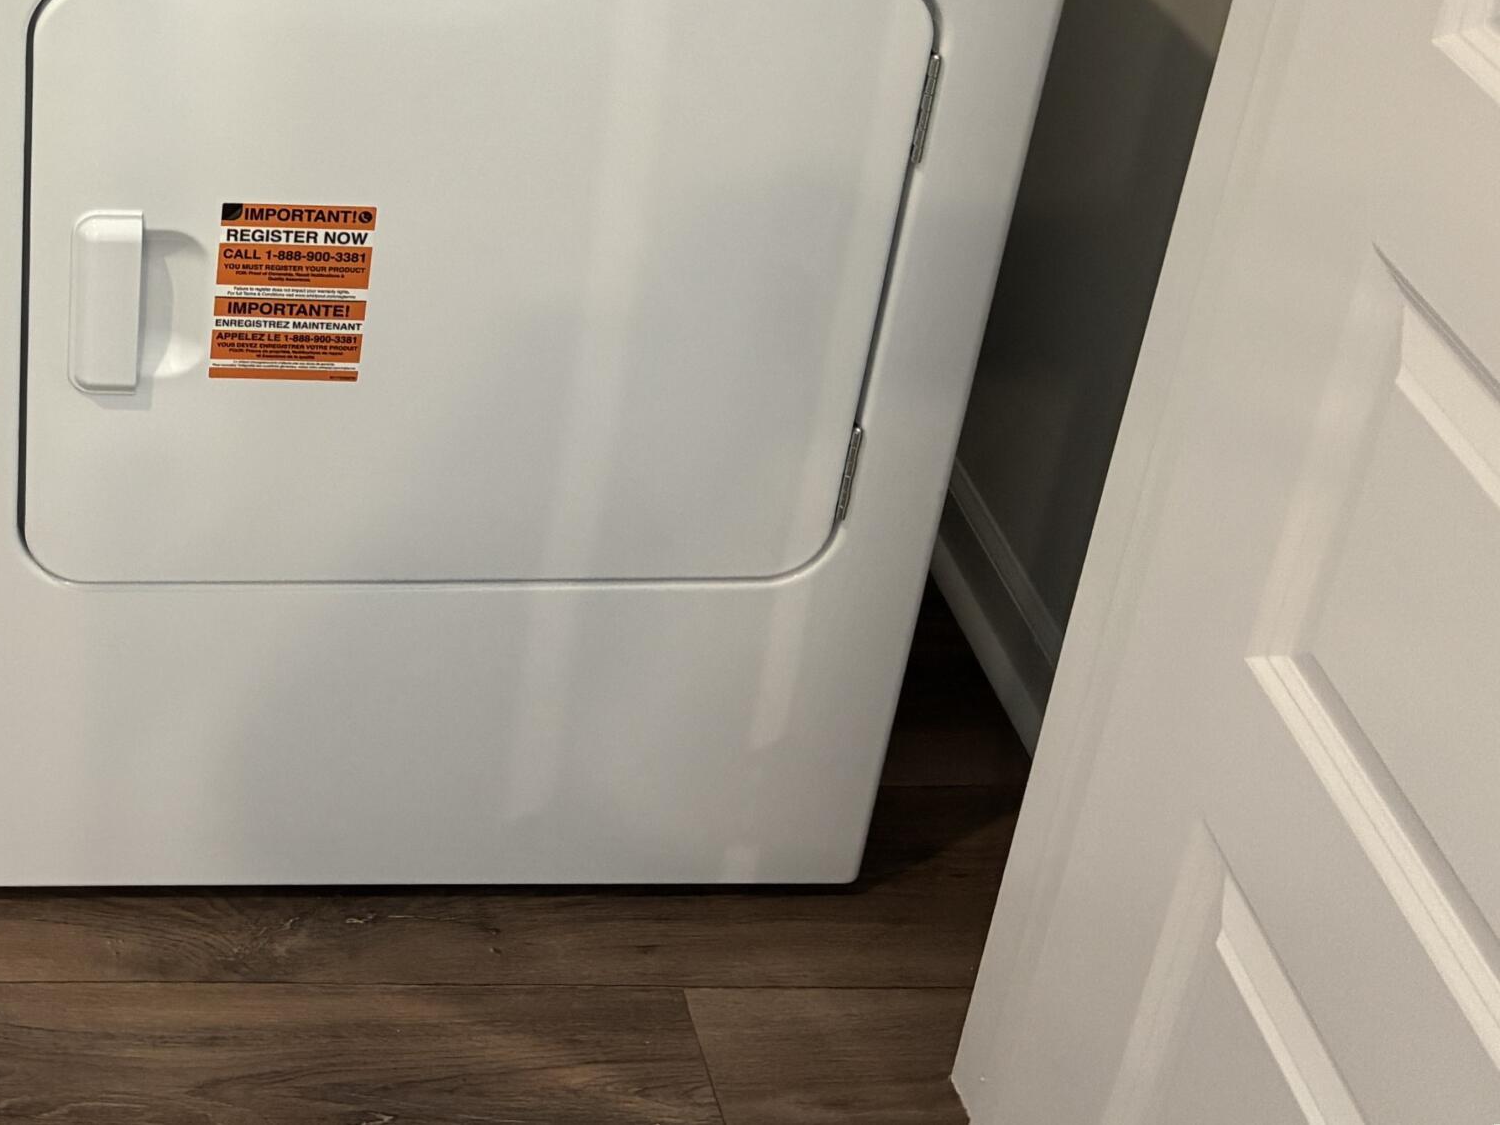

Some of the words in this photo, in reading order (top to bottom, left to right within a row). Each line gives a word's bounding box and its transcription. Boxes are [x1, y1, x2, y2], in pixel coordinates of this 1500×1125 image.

[244, 207, 357, 223] IMPORTANT!
[226, 228, 318, 244] REGISTER
[324, 231, 368, 245] NOW
[223, 248, 261, 260] CALL
[265, 250, 366, 263] 1-888-900-3381
[242, 263, 264, 271] MUST
[265, 264, 304, 272] REGISTER
[305, 265, 327, 273] YOUR
[328, 266, 366, 274] PRODUCT
[227, 301, 350, 318] IMPORTANTE!
[215, 318, 290, 329] ENREGISTREZ
[293, 321, 362, 331] MAINTENANT
[216, 332, 265, 342] APPELEZ
[267, 333, 281, 342] LE
[284, 334, 357, 344] 1-888-900-3381
